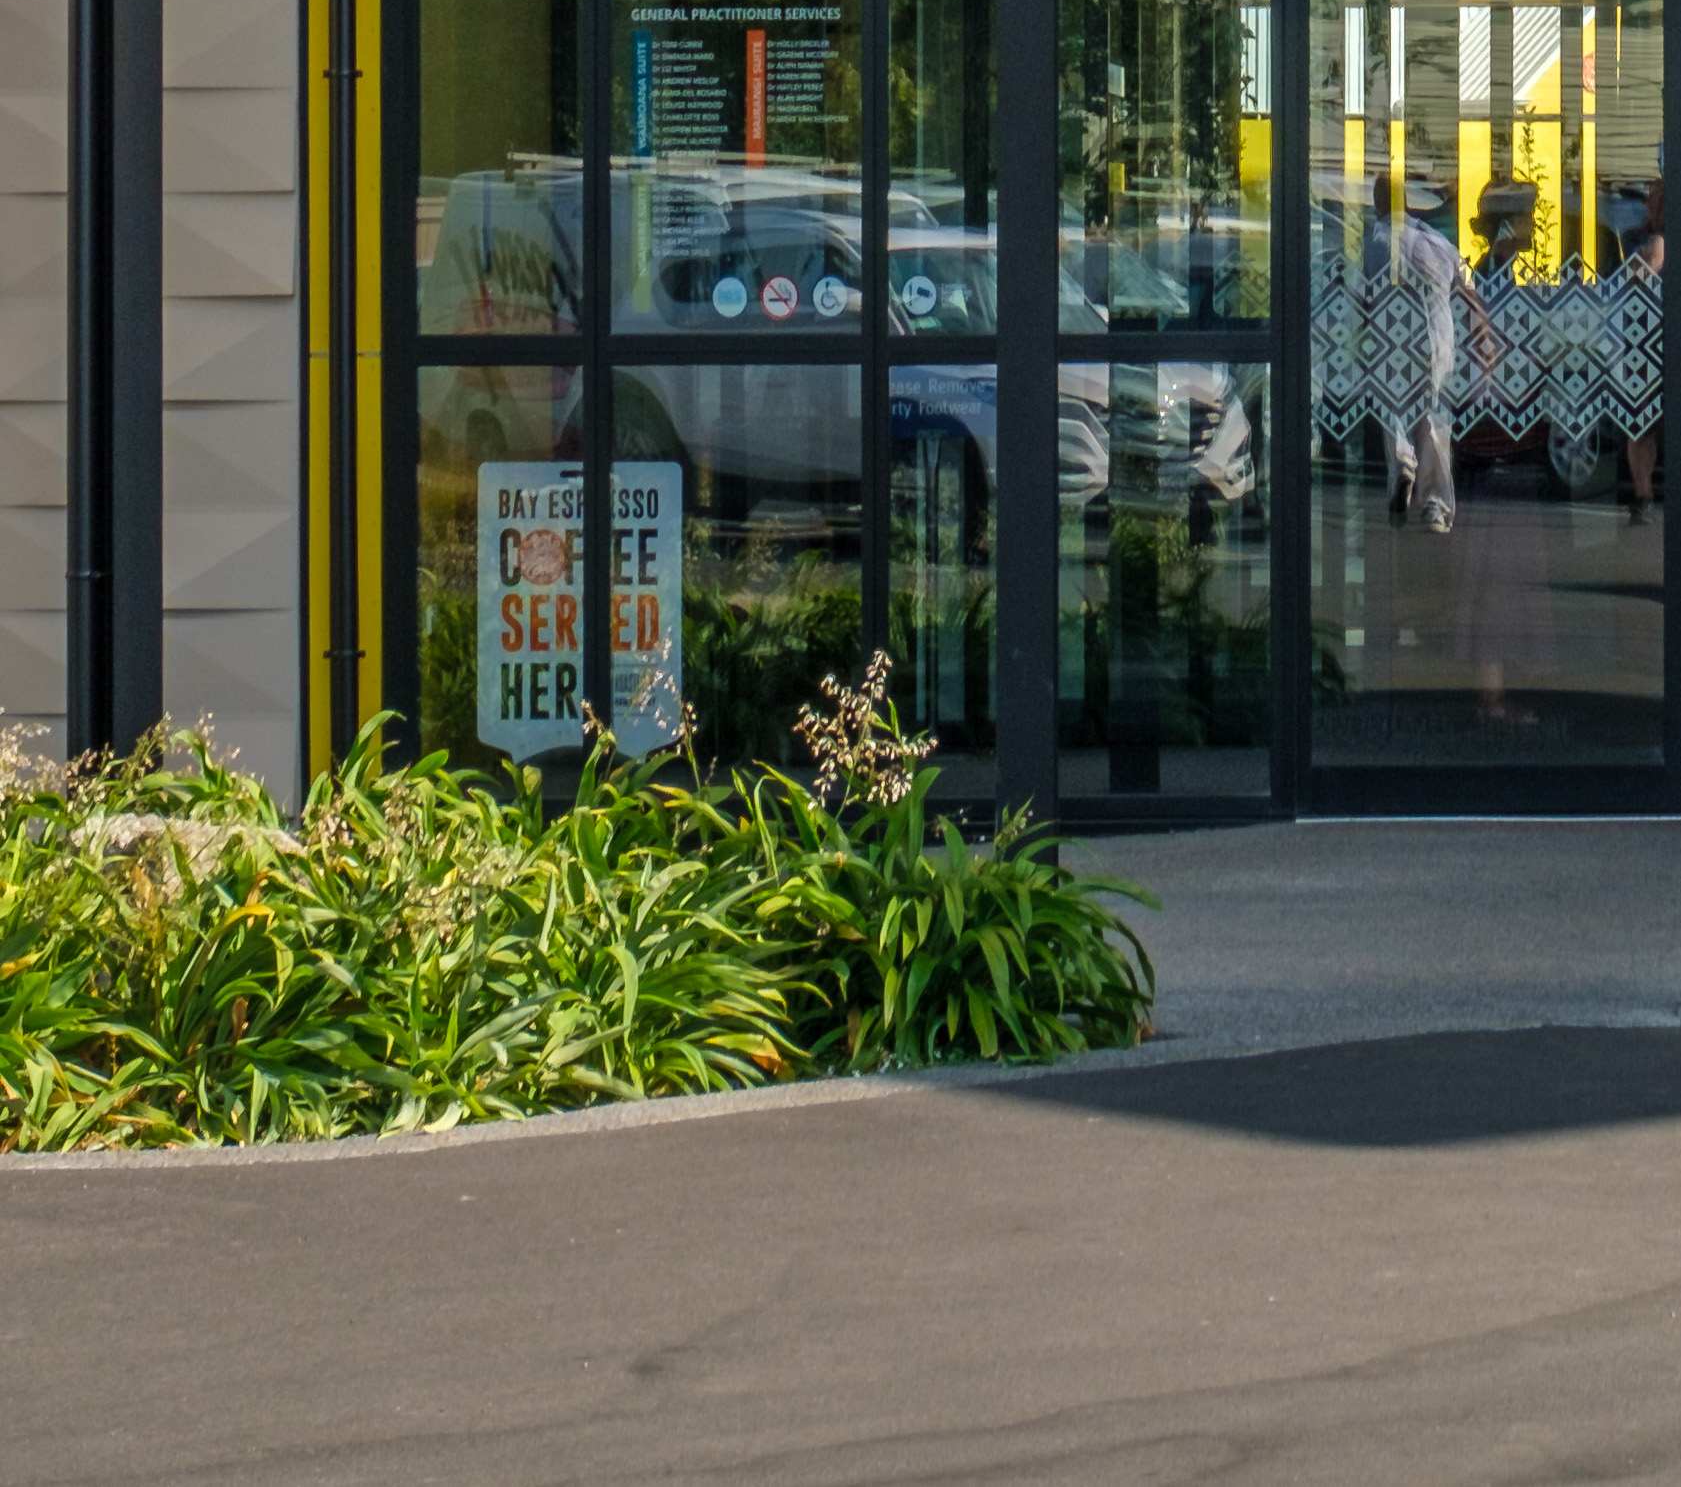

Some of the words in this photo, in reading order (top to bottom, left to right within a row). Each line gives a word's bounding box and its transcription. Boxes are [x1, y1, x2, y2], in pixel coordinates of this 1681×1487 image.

[631, 8, 688, 21] GENERAL
[691, 8, 782, 21] PRACTITIONER
[785, 8, 841, 21] SERVICES
[637, 41, 648, 74] SUITE
[752, 41, 763, 74] SUITE
[889, 381, 921, 394] ease
[928, 377, 986, 394] Remove
[892, 401, 912, 419] rty
[919, 399, 983, 415] Footwear
[499, 489, 538, 520] BAY
[548, 489, 660, 520] ESPSSO
[499, 528, 659, 587] COFEE
[500, 593, 660, 653] SERED
[500, 662, 579, 721] HER
